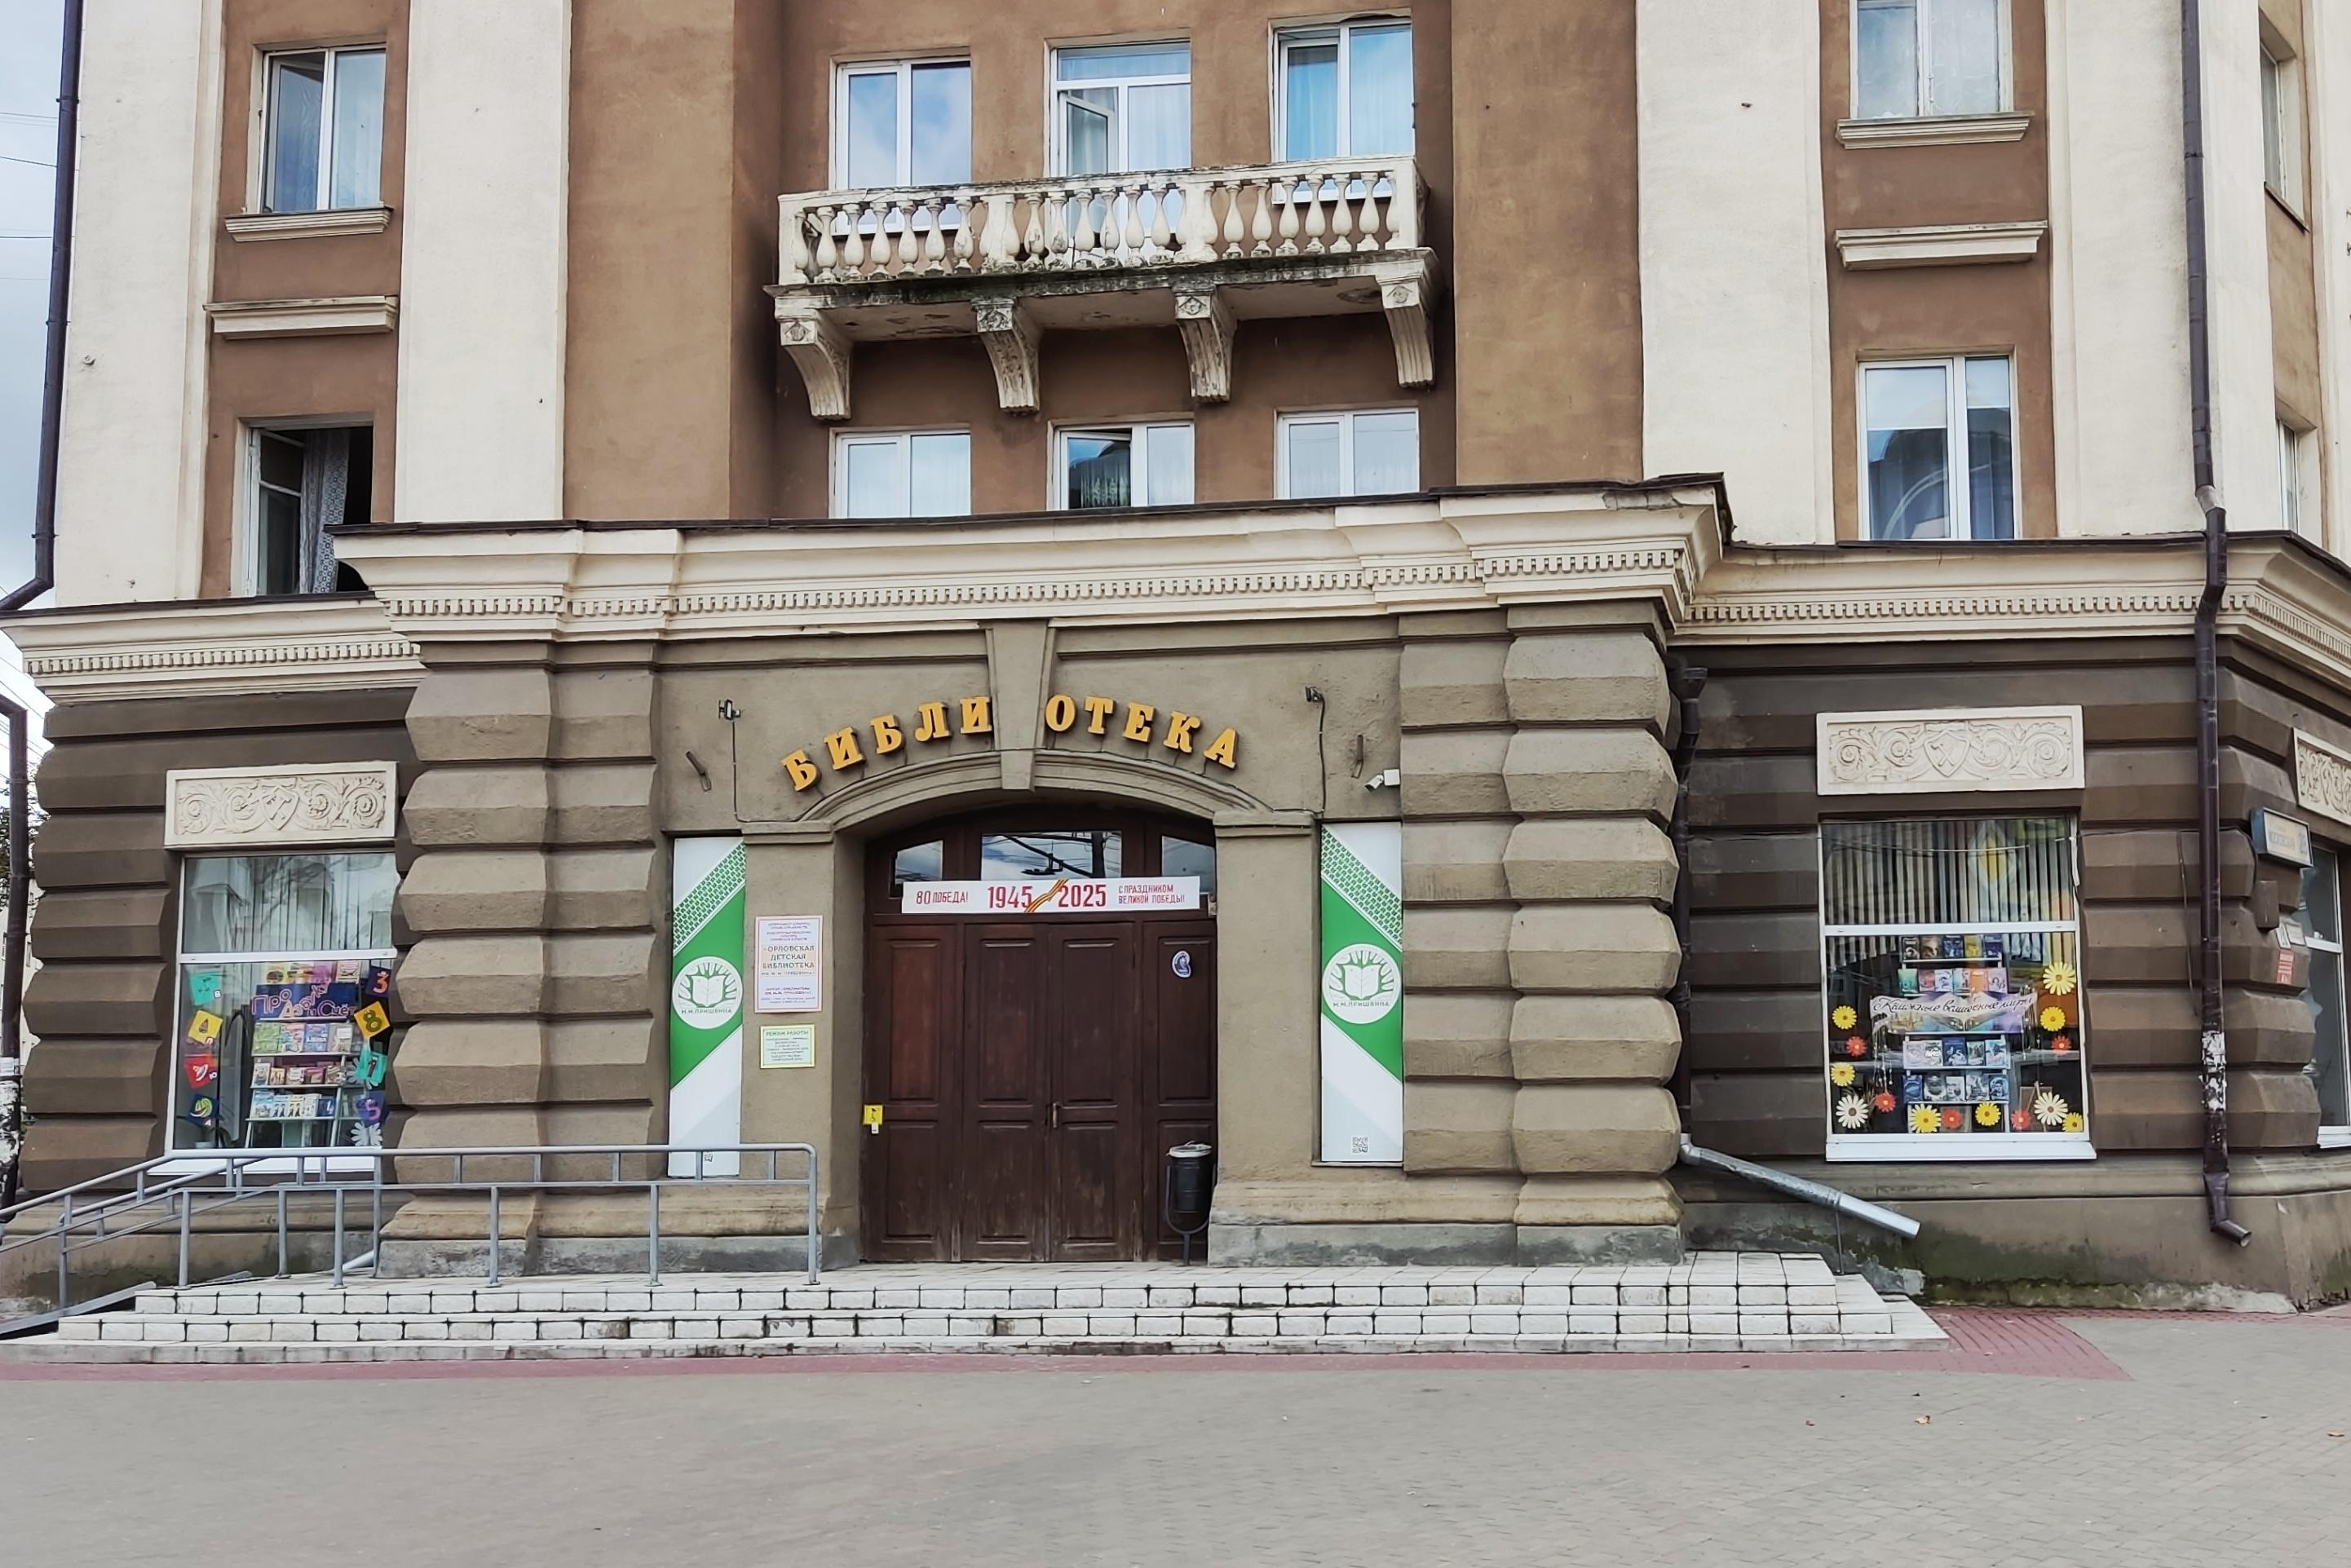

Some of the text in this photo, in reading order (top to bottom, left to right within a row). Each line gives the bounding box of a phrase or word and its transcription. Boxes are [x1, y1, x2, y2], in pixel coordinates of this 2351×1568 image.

[916, 884, 1107, 908] 80 ПОБЕДА! 1945 2025
[1118, 884, 1174, 894] С ПРАЗДНИКОМ
[1118, 894, 1149, 904] ВЕЛИКОЙ
[771, 953, 806, 961] ДЕТСКАЯ
[372, 971, 389, 994] 3
[363, 1009, 383, 1032] 8
